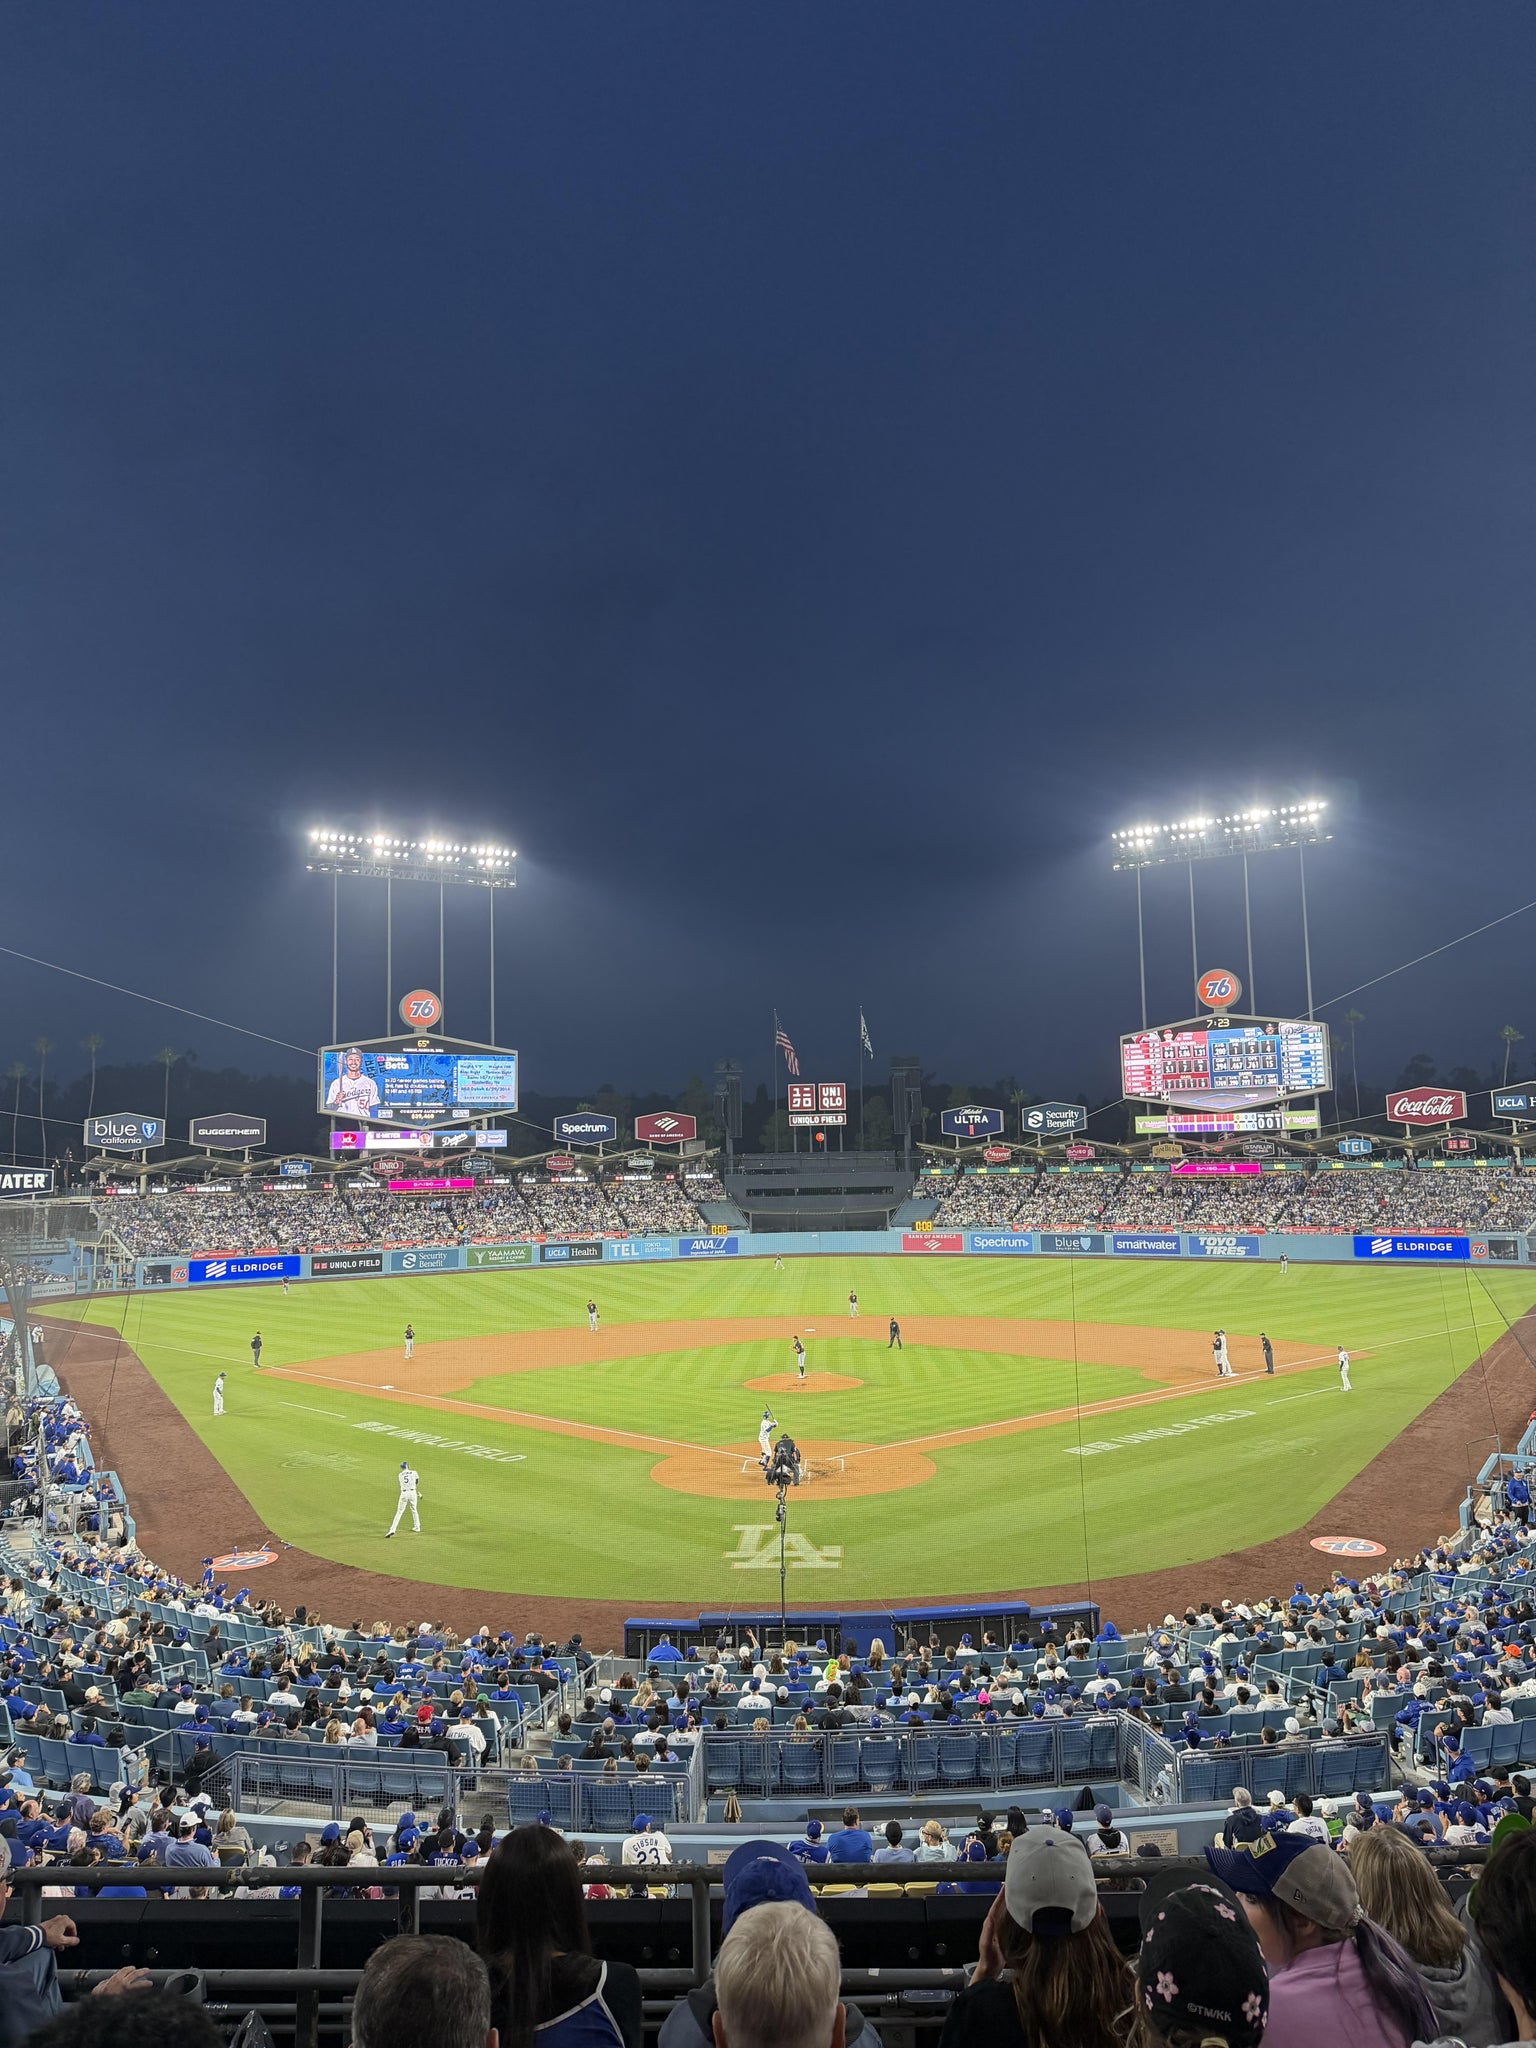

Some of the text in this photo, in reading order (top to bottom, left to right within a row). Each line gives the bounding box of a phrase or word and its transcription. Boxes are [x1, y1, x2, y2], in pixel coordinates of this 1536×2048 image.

[1205, 978, 1231, 998] 76
[410, 1000, 434, 1017] 76
[1206, 1018, 1230, 1028] 7:23
[384, 1062, 409, 1070] Betts
[822, 1087, 841, 1096] UNI
[822, 1097, 842, 1108] QLO
[1393, 1095, 1456, 1117] Coca-Cola
[1498, 1098, 1524, 1107] UCLA
[954, 1115, 989, 1123] ULTRA
[1046, 1109, 1079, 1119] Security
[792, 1116, 819, 1125] UNIQLO
[1046, 1119, 1076, 1128] Benefit
[94, 1121, 137, 1137] blue
[198, 1128, 260, 1136] GUGGENHEIM
[561, 1123, 607, 1135] Spectrum
[100, 1136, 142, 1144] california
[442, 1133, 468, 1147] Dodgers
[1342, 1142, 1367, 1152] TEL
[915, 1221, 932, 1232] 0:08
[690, 1240, 714, 1250] ANA
[974, 1236, 1025, 1249] Spectrum
[1055, 1237, 1080, 1247] blue
[1117, 1239, 1176, 1250] smartwater
[1199, 1237, 1236, 1246] TOYO
[1396, 1242, 1453, 1251] ELDRIDGE
[548, 1247, 598, 1257] UCLA Health
[611, 1243, 640, 1257] TEL
[1205, 1246, 1246, 1256] TIRES
[1472, 1245, 1485, 1254] 76
[419, 1252, 447, 1261] Security
[230, 1262, 284, 1273] ELDRIDGE
[329, 1259, 381, 1269] UNIQLO FIELD
[419, 1260, 444, 1268] Benefit
[172, 1269, 188, 1280] 76
[1111, 1409, 1257, 1444] UNIQLO FIELD
[387, 1428, 528, 1463] UNIQLO FIELD
[403, 1475, 409, 1484] 5
[722, 1524, 844, 1569] LA
[1320, 1540, 1378, 1553] 76
[209, 1552, 274, 1568] 76
[632, 1838, 659, 1852] GIBSON
[636, 1847, 661, 1865] 23
[433, 1857, 459, 1867] TUCKER
